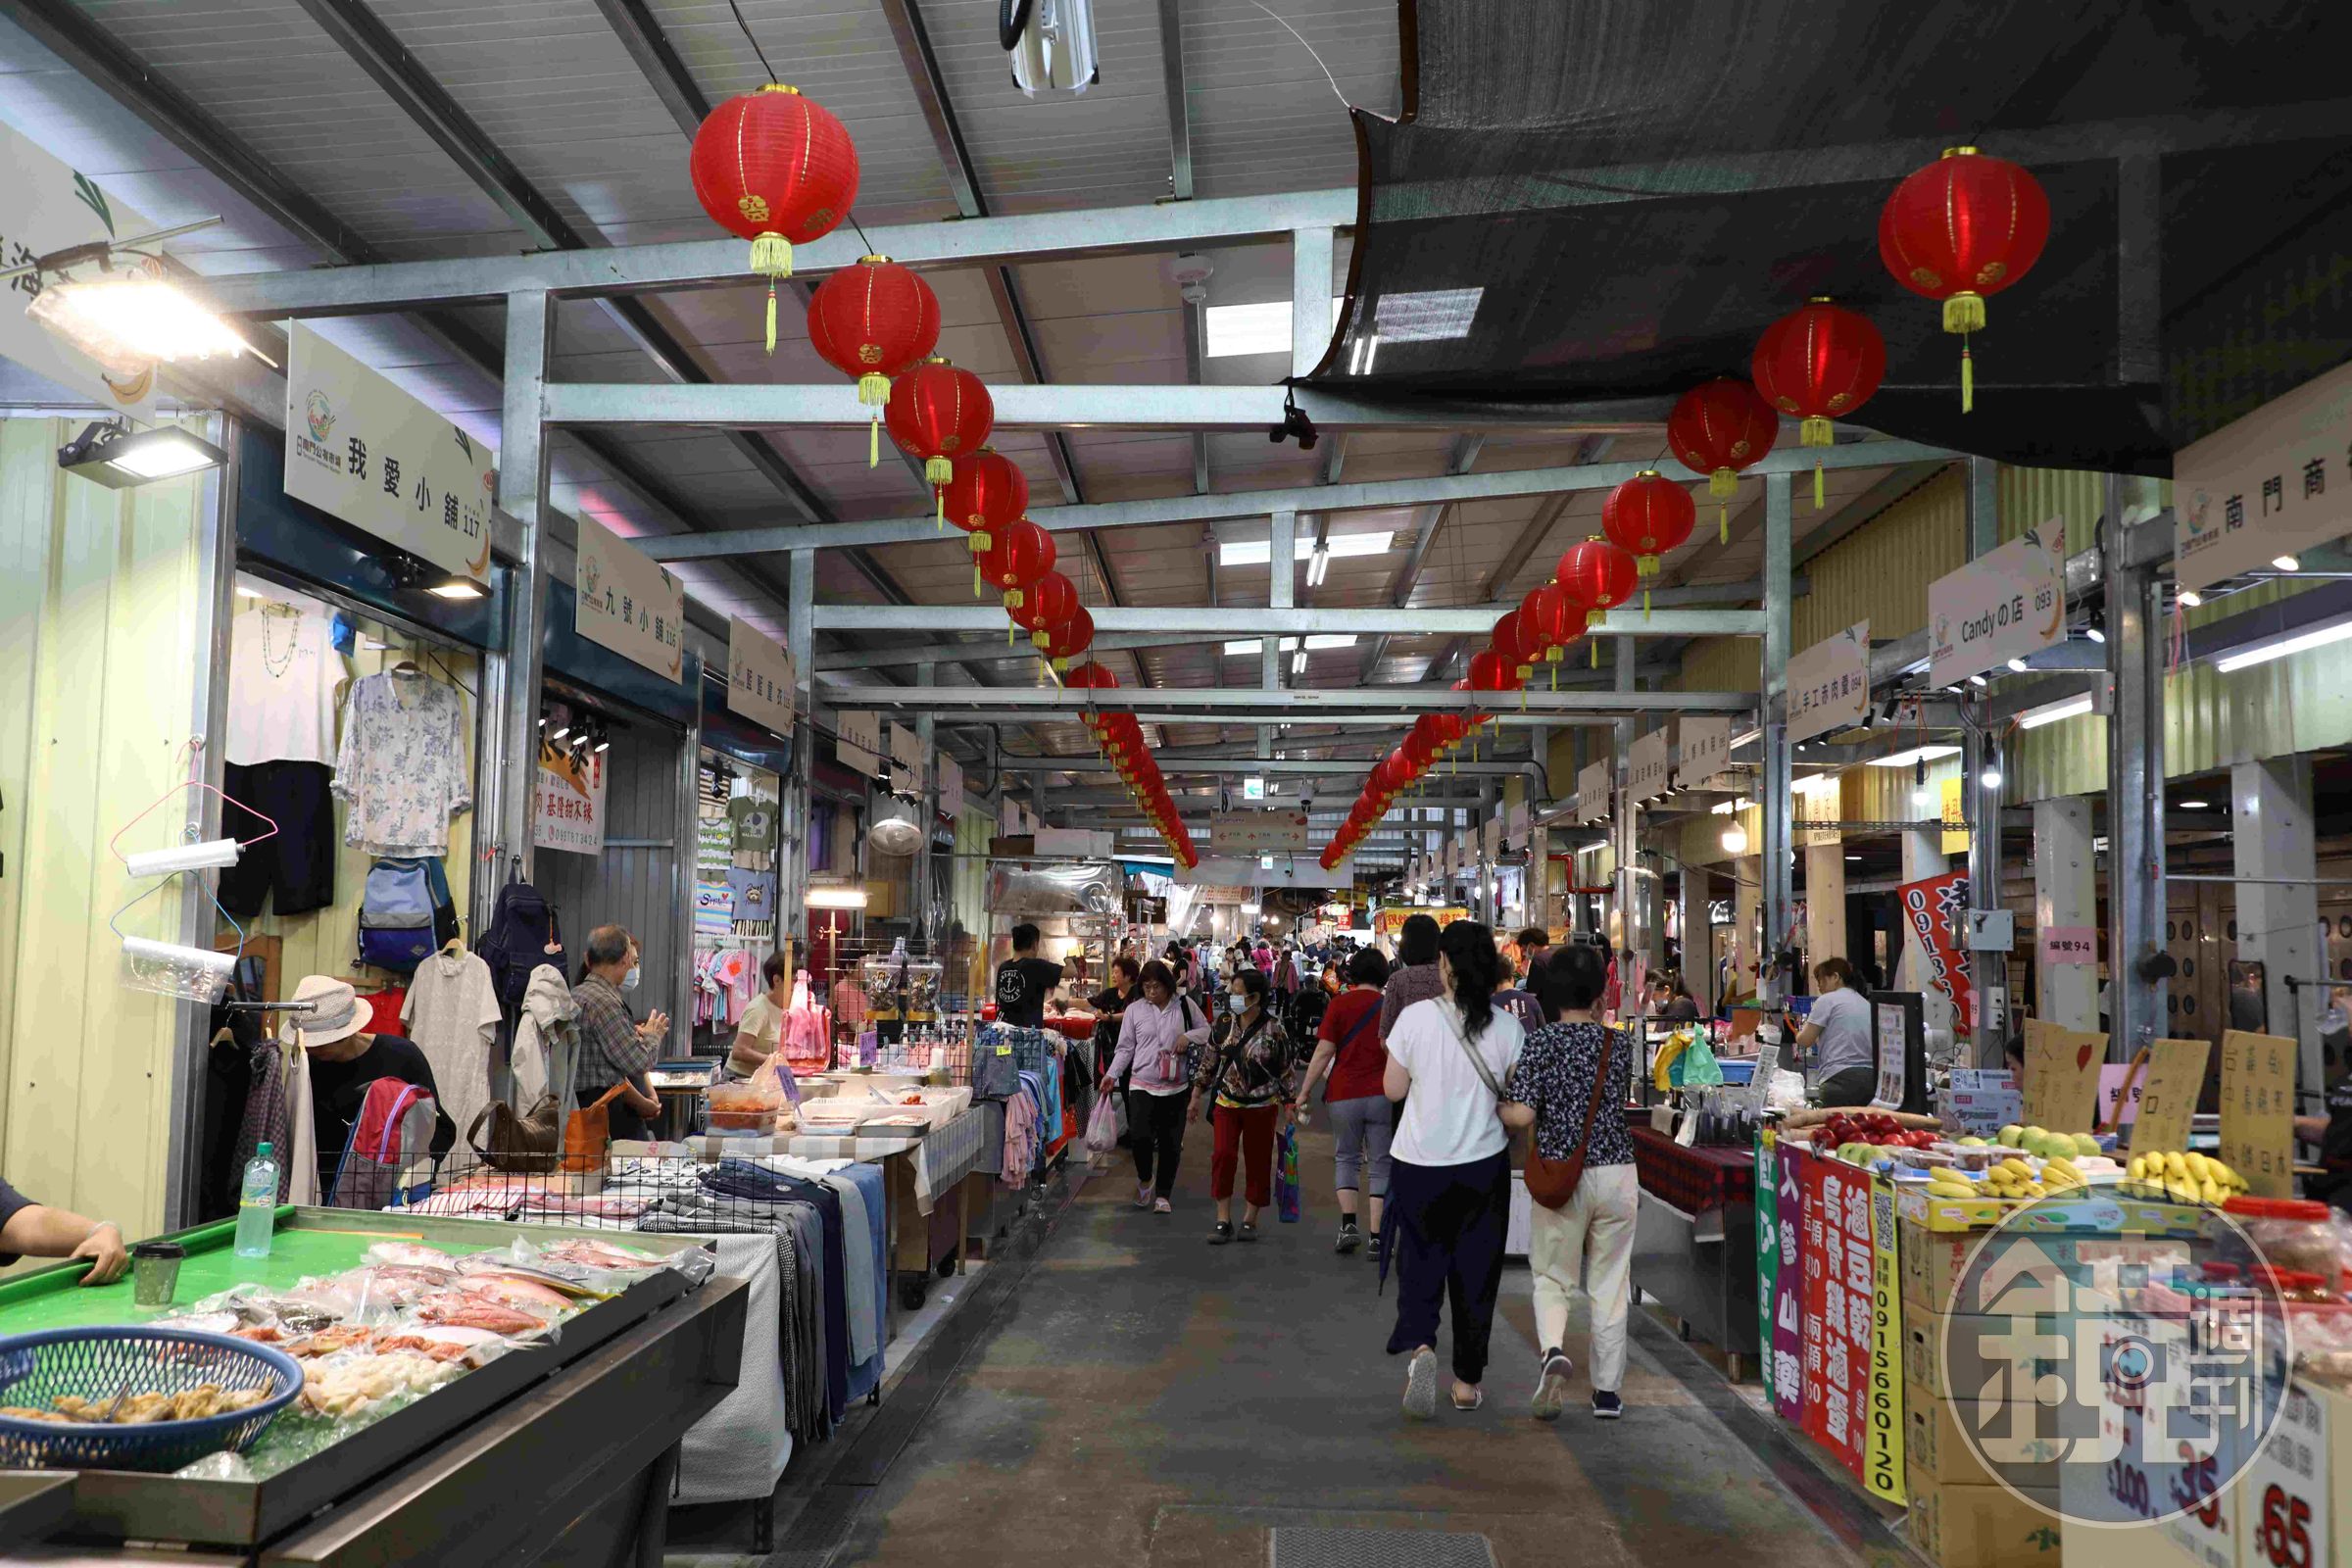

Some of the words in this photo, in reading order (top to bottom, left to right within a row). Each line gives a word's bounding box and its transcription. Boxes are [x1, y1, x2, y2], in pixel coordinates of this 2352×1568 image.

[348, 437, 459, 531] 我愛小舖
[464, 514, 480, 539] 117
[2226, 441, 2352, 534] 南門商
[606, 585, 664, 644] 九號小舖
[666, 630, 676, 648] 116
[2034, 590, 2051, 612] 093
[547, 792, 594, 825] 基隆甜不辣
[2049, 940, 2090, 953] 編號94
[1775, 1156, 1800, 1404] 人參山藥
[1824, 1174, 1849, 1446] 烏骨雞滷蛋
[1844, 1185, 1873, 1353] 滷豆乾
[1874, 1291, 1893, 1492] 0915660120
